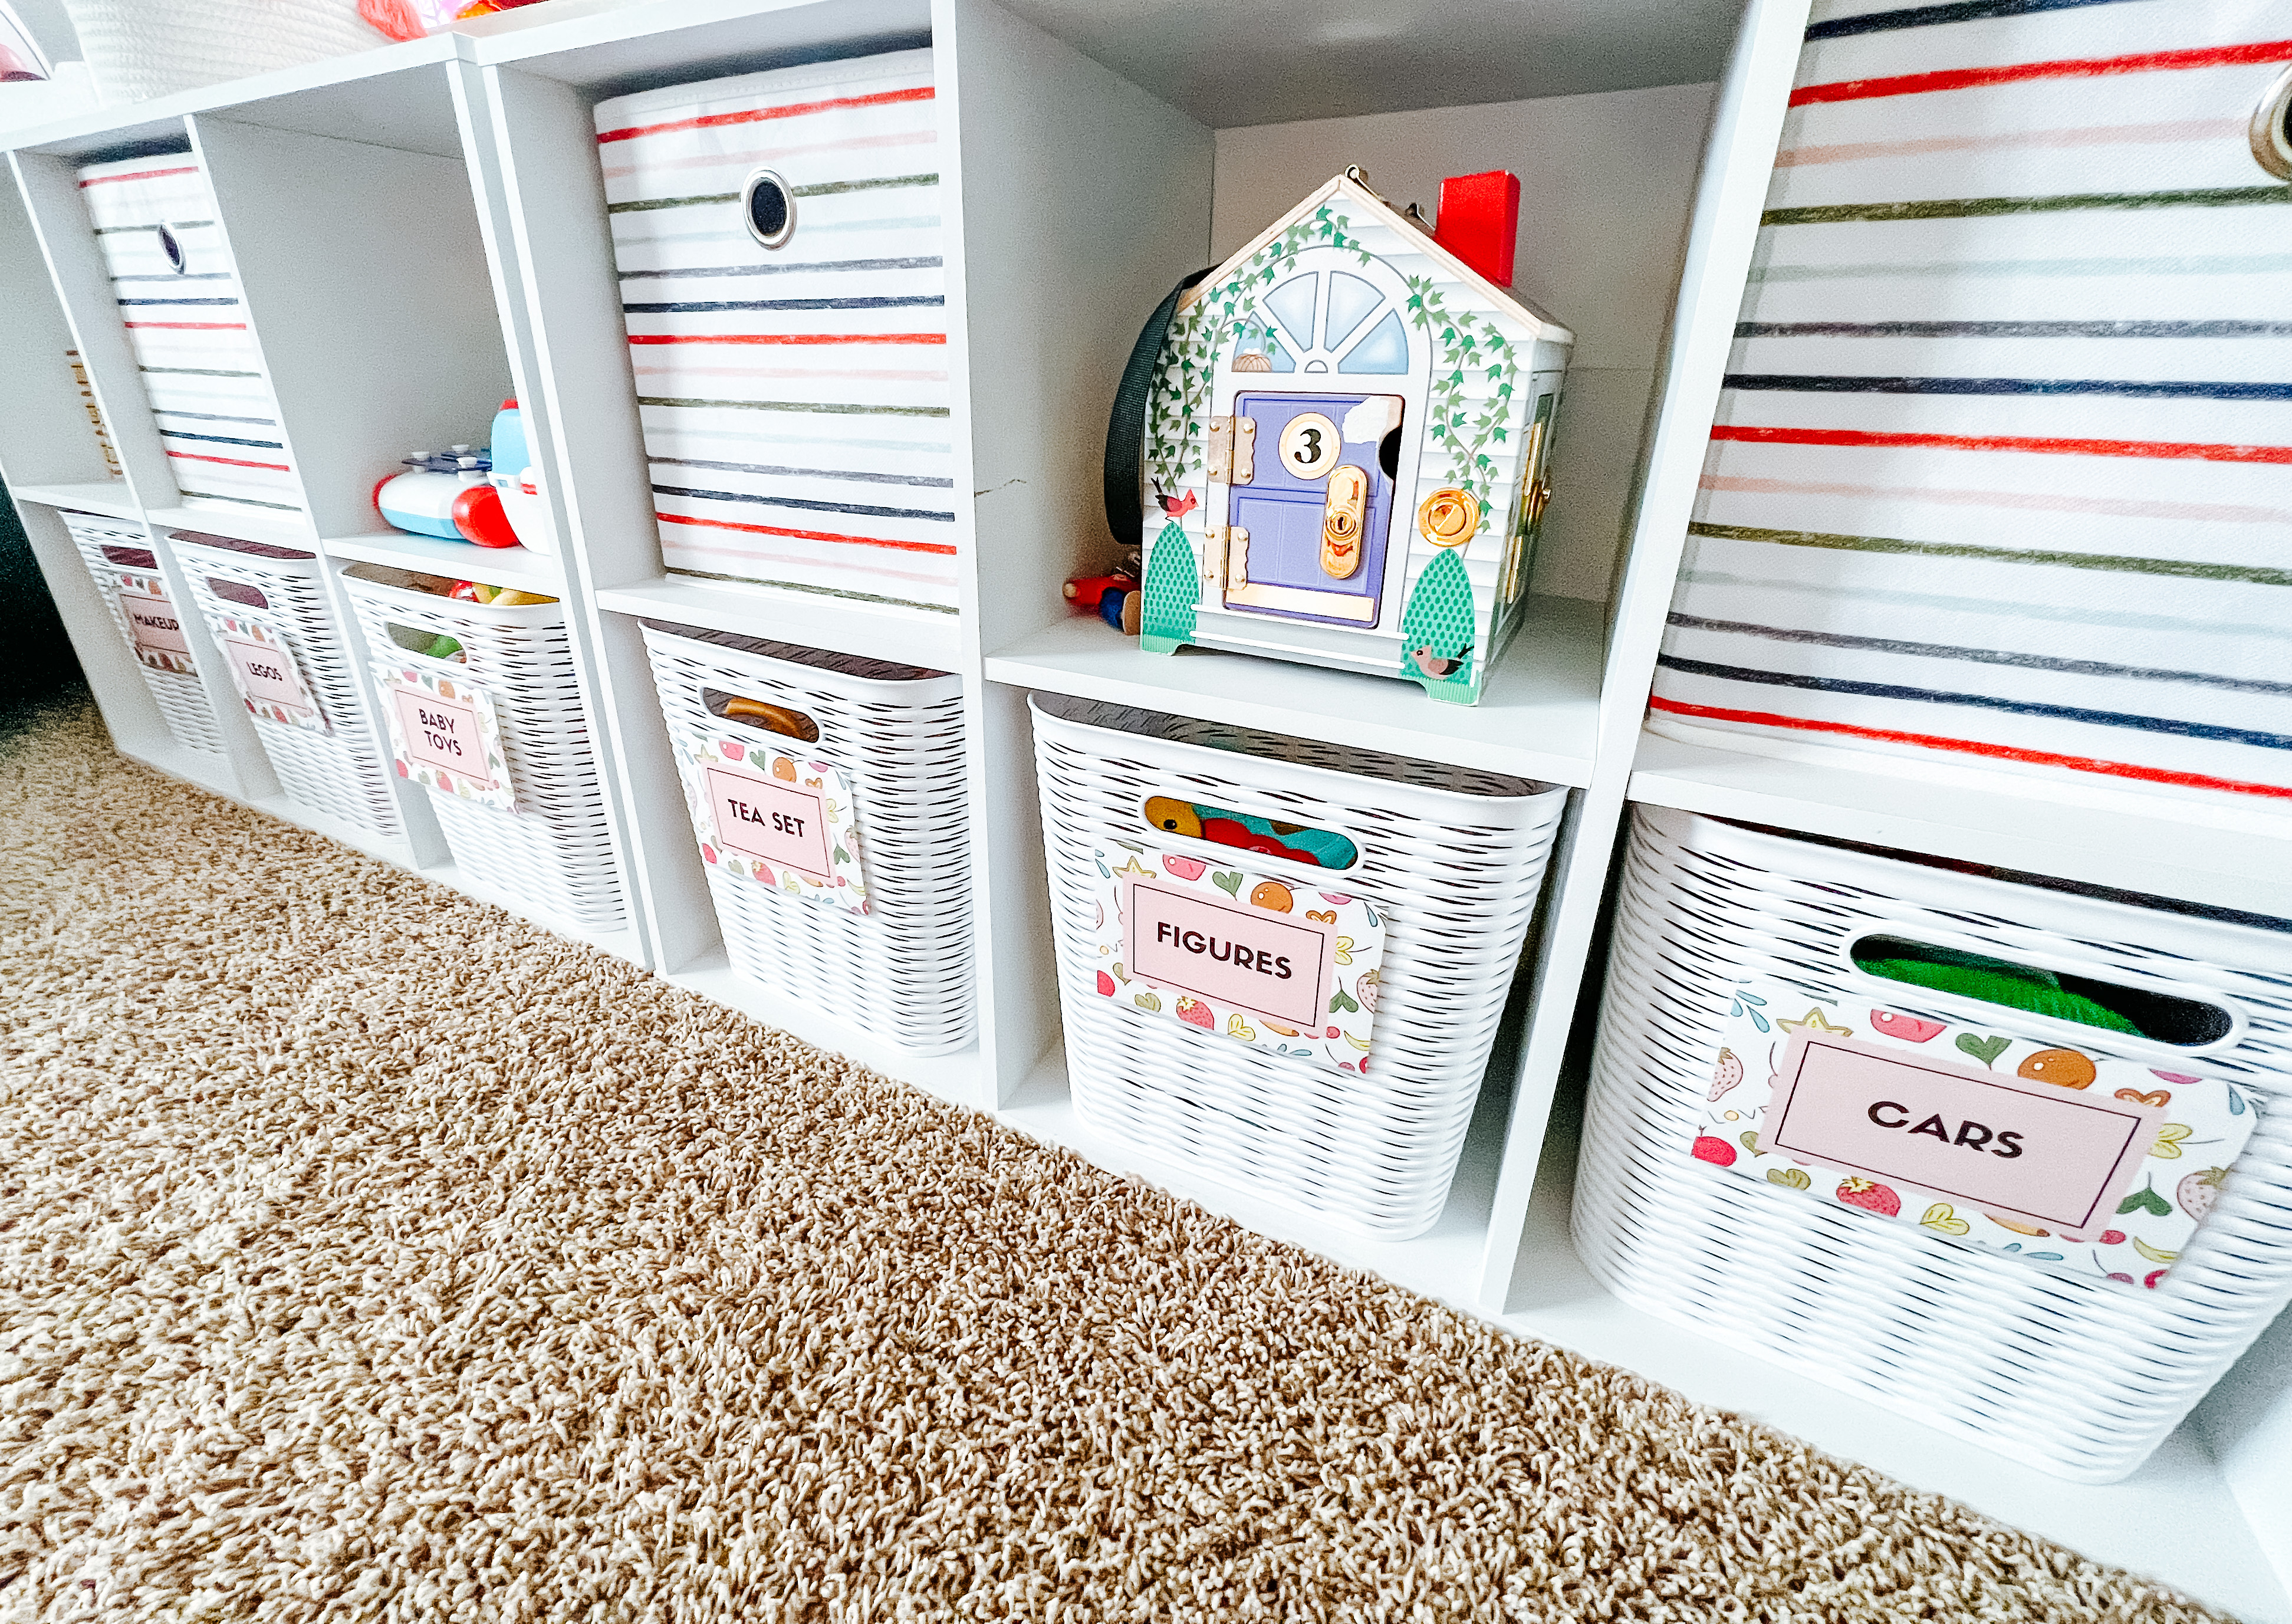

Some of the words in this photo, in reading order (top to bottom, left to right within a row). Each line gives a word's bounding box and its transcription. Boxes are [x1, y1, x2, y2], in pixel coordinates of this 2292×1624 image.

[1294, 428, 1321, 463] 3
[133, 614, 179, 630] MAKEUP
[246, 662, 282, 681] LEGOS
[419, 708, 455, 734] BABY
[424, 730, 462, 756] TOYS
[728, 798, 766, 827] TEA
[772, 811, 805, 837] SET
[1157, 921, 1292, 979] FIGURES
[1867, 1100, 2024, 1159] CARS
